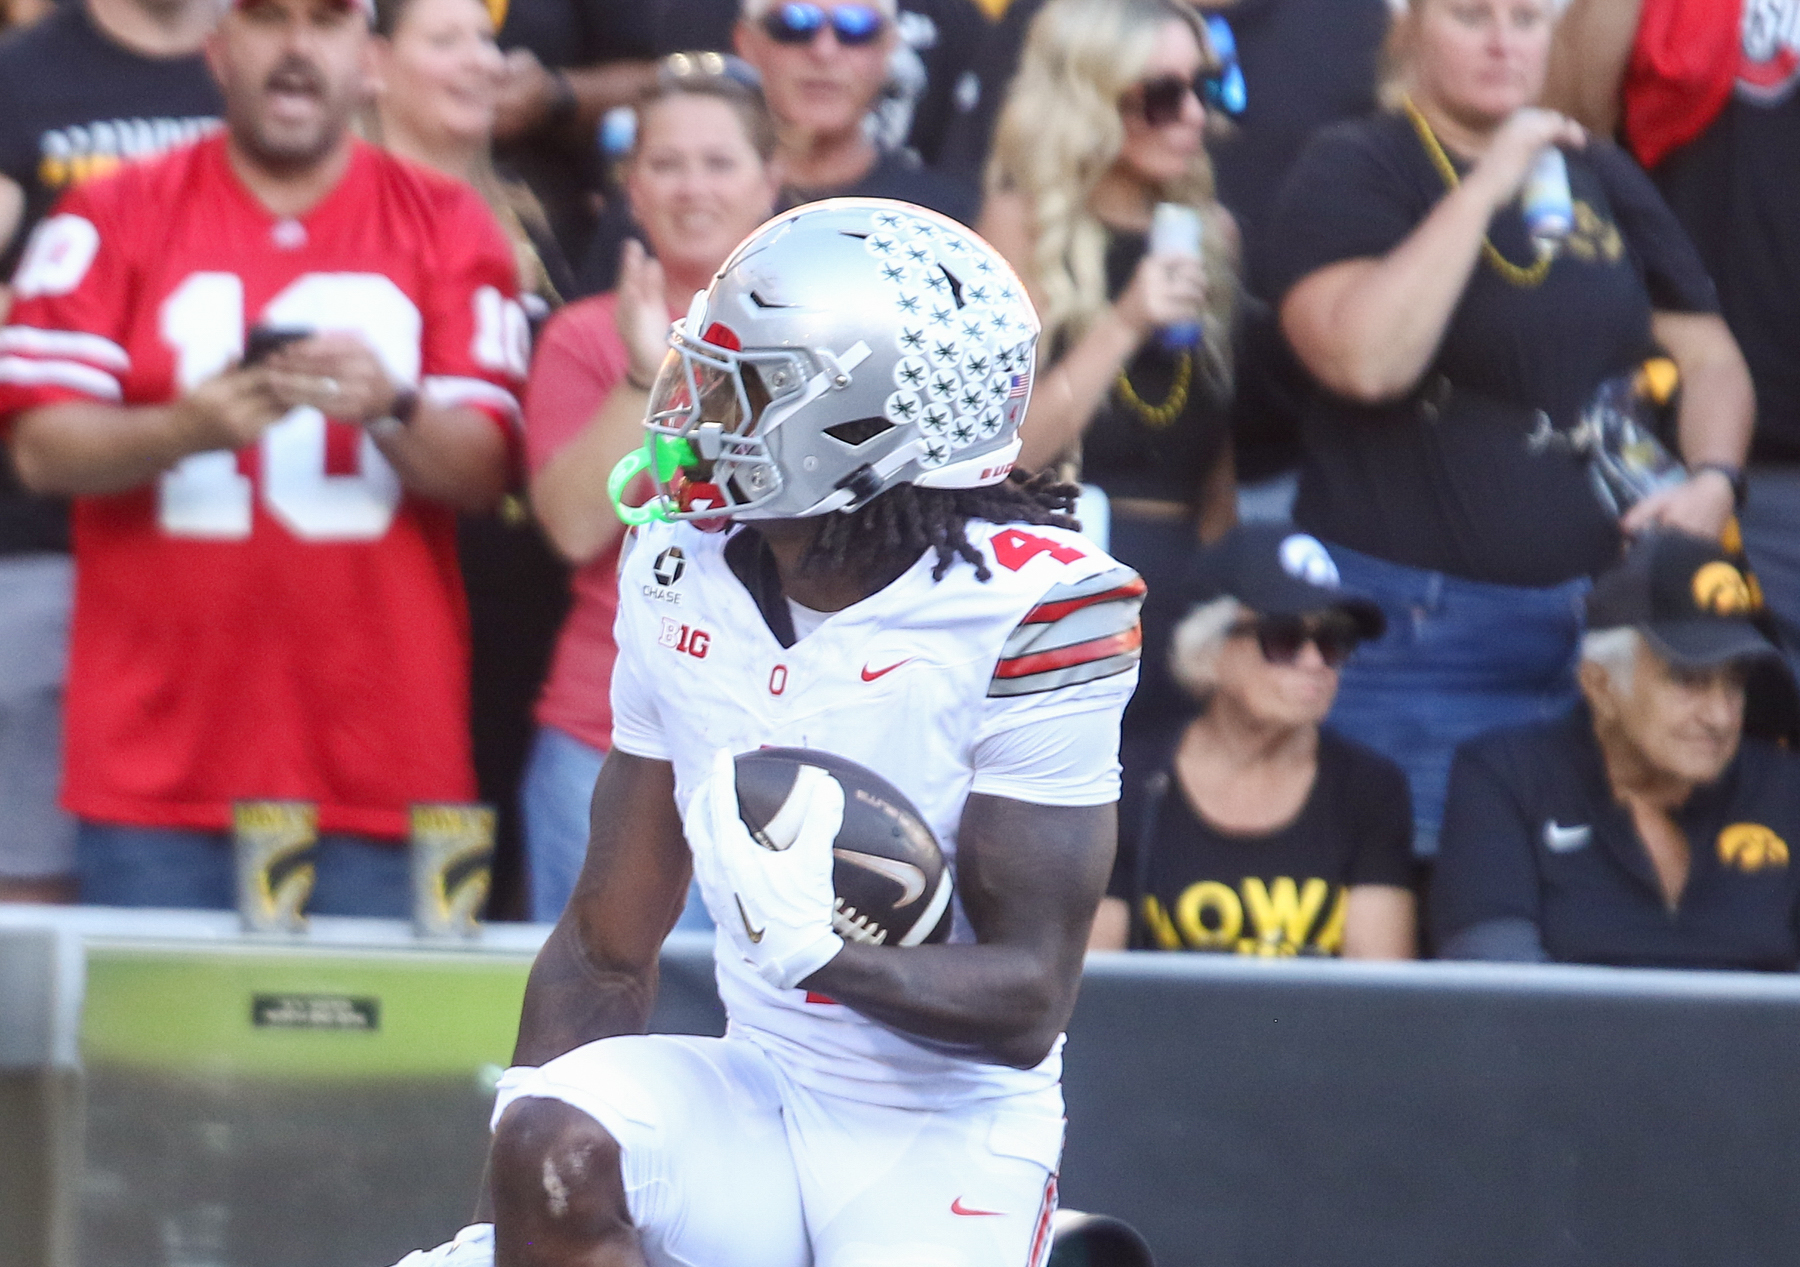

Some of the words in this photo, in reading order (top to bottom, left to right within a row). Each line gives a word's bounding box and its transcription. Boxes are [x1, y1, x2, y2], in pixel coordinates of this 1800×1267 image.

[160, 271, 422, 540] 10
[989, 528, 1087, 572] 4
[642, 585, 682, 605] CHASE
